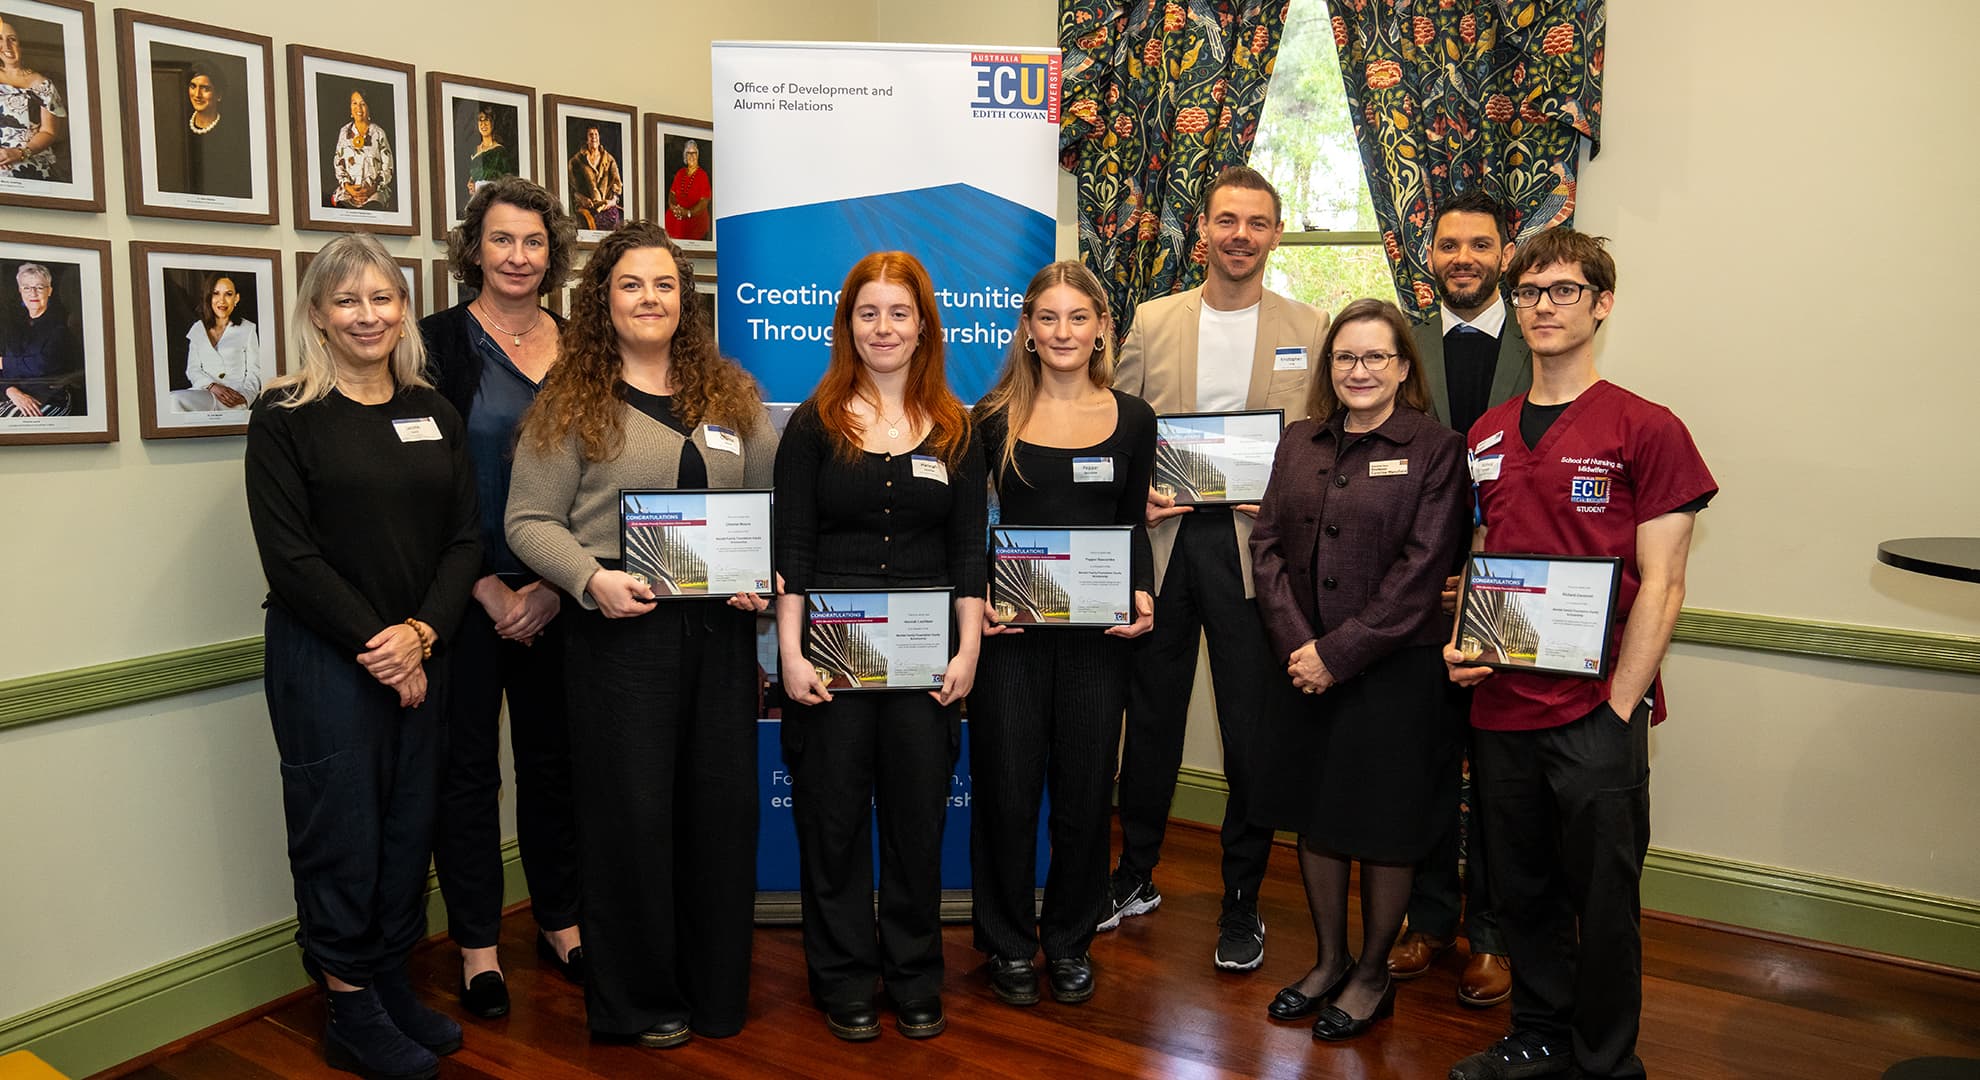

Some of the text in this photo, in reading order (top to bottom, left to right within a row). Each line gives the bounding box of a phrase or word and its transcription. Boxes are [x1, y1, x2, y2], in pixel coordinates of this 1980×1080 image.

[973, 54, 1020, 63] AUSTRALIA
[733, 81, 893, 97] Office of Development and
[971, 66, 1045, 106] ECU
[1049, 59, 1059, 121] UNIVERSITY
[733, 98, 834, 112] Alumni Relations
[973, 110, 1047, 120] EDITH COWAN
[747, 318, 834, 347] Throug
[1560, 456, 1582, 464] School
[1590, 458, 1616, 468] Nursing
[1577, 465, 1609, 474] Midwifery
[1572, 480, 1606, 497] ECU
[1471, 577, 1522, 586] CONGRATULATIONS
